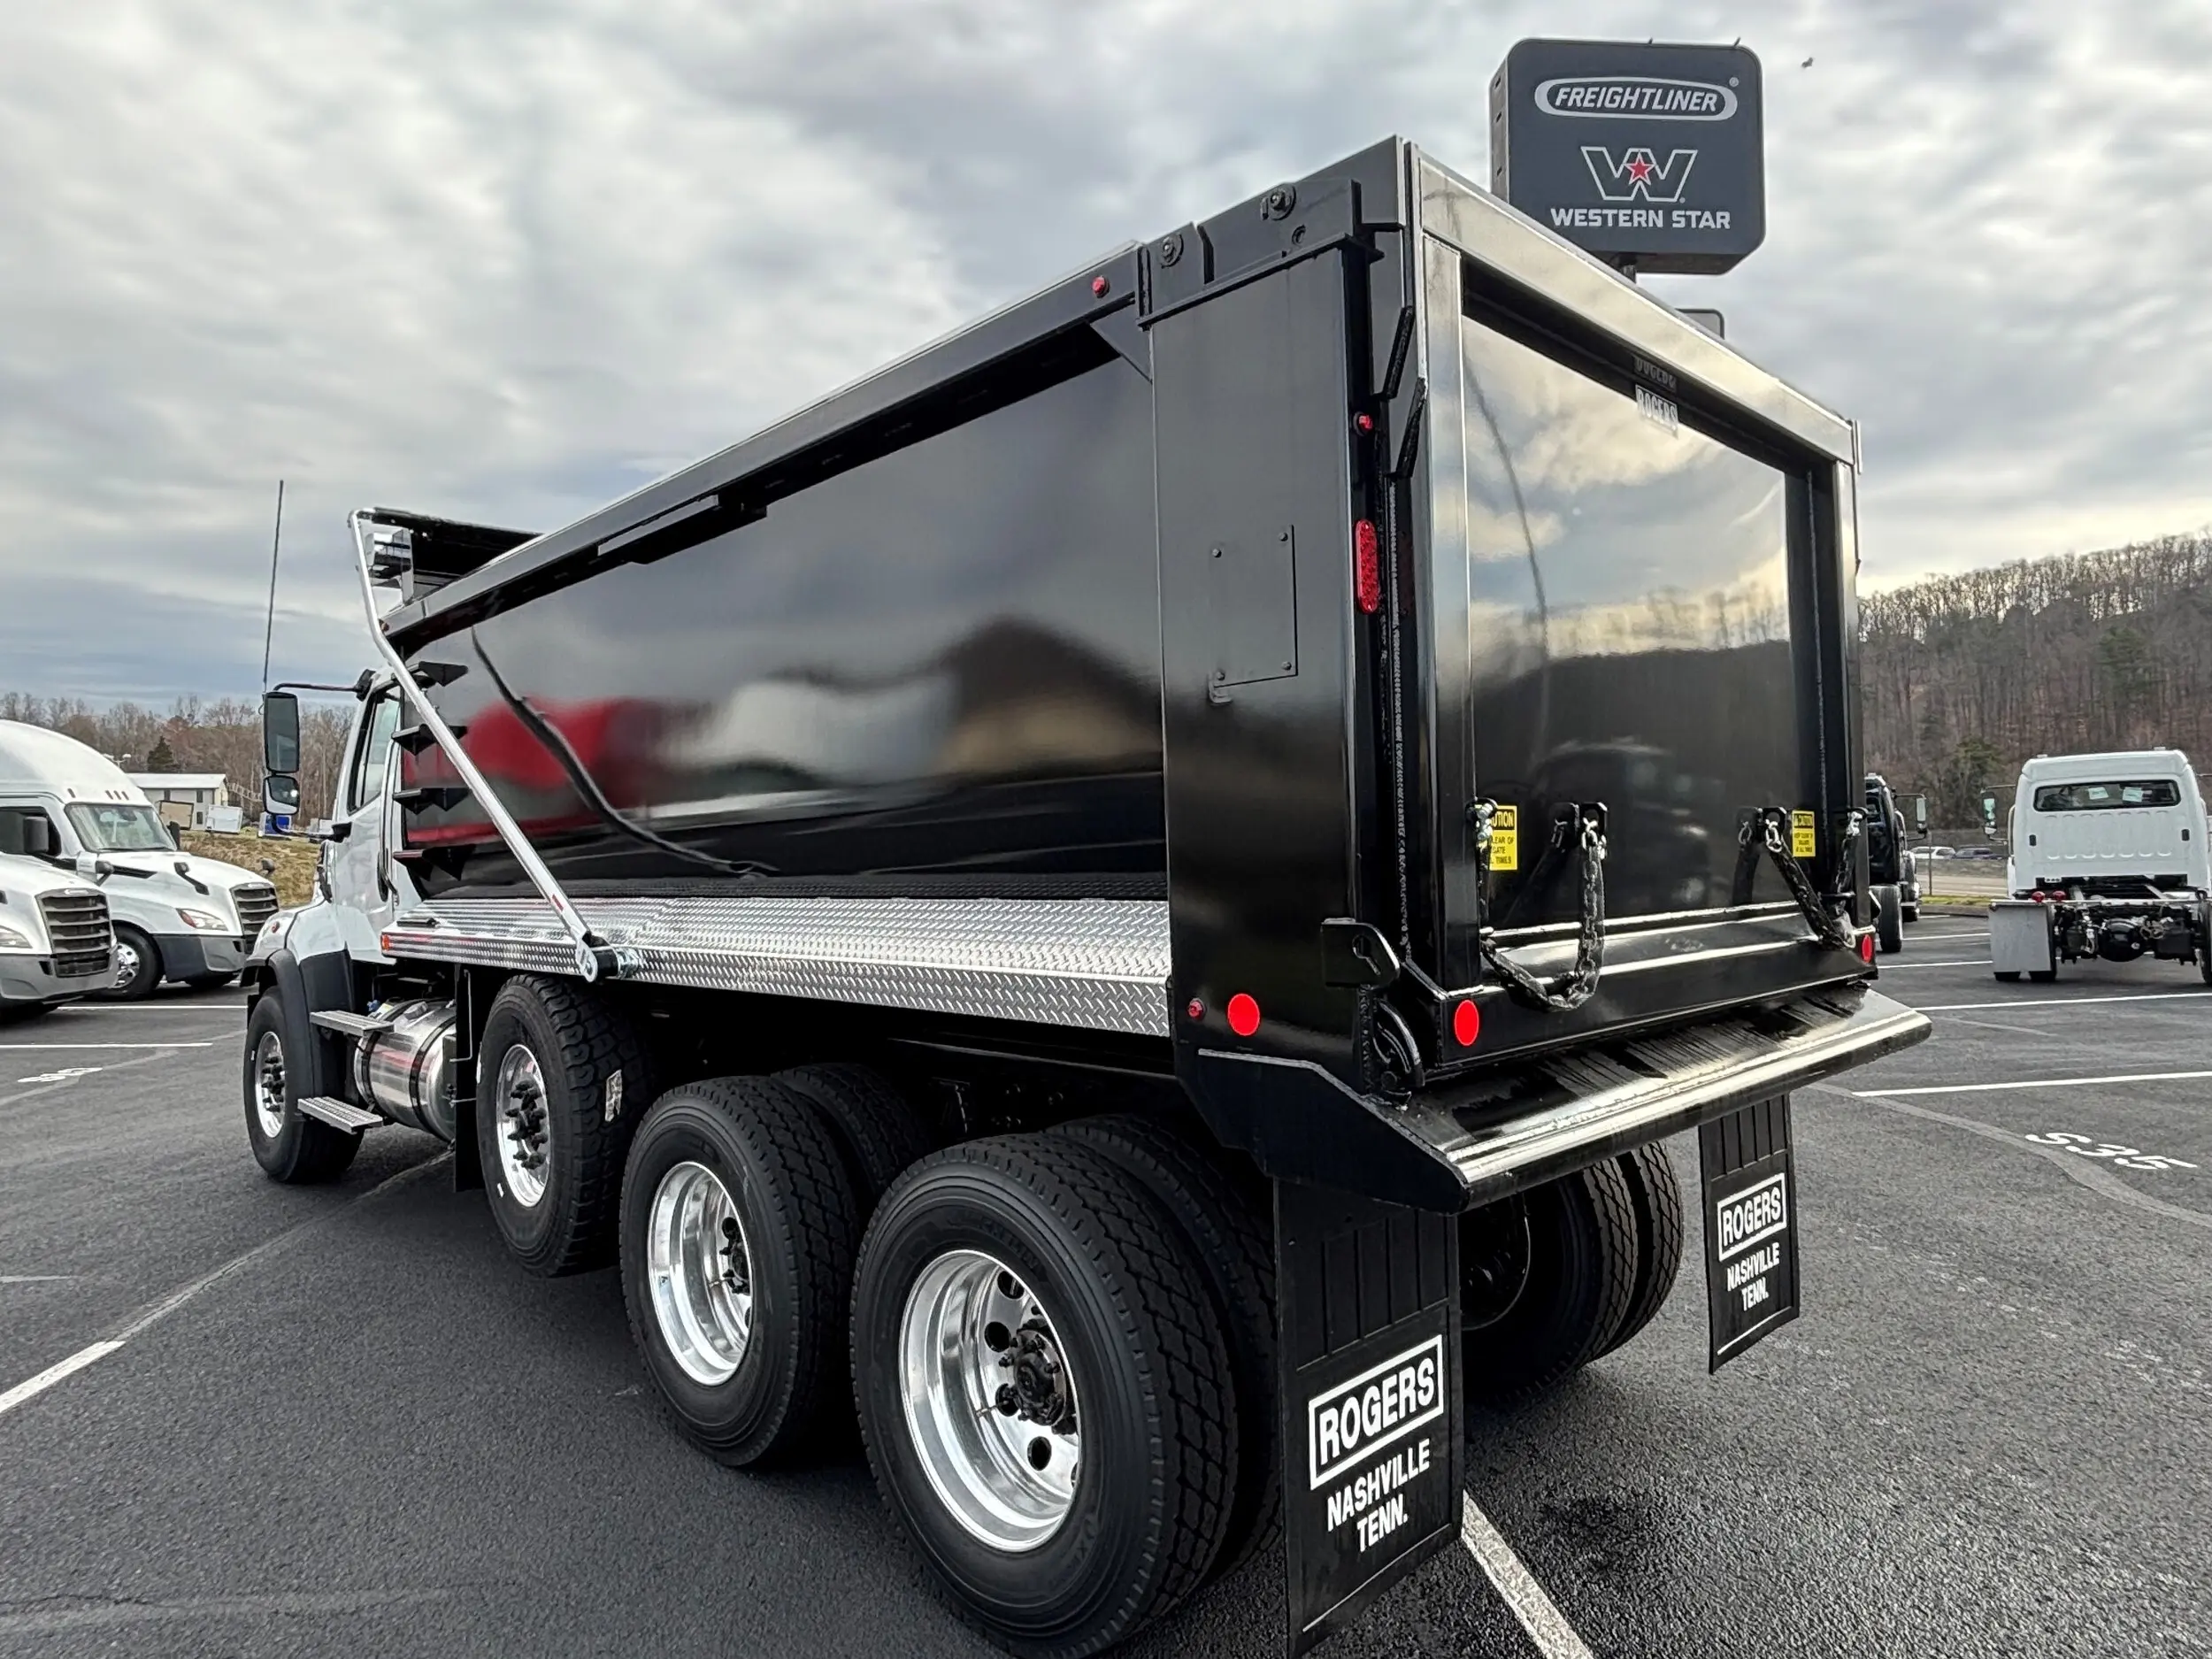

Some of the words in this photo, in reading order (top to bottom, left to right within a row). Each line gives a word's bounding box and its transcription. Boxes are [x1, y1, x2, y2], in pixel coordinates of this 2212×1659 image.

[1555, 86, 1718, 112] FREIGHTLINER
[1550, 208, 1663, 227] WESTERN
[1671, 210, 1731, 229] STAR
[1722, 1187, 1781, 1246] ROGERS
[1726, 1241, 1780, 1292] NASHVILLE
[1740, 1277, 1770, 1311] TENN.
[1318, 1357, 1435, 1465] ROGERS
[1327, 1438, 1430, 1532] NASHVILLE
[1356, 1494, 1409, 1553] TENN.
